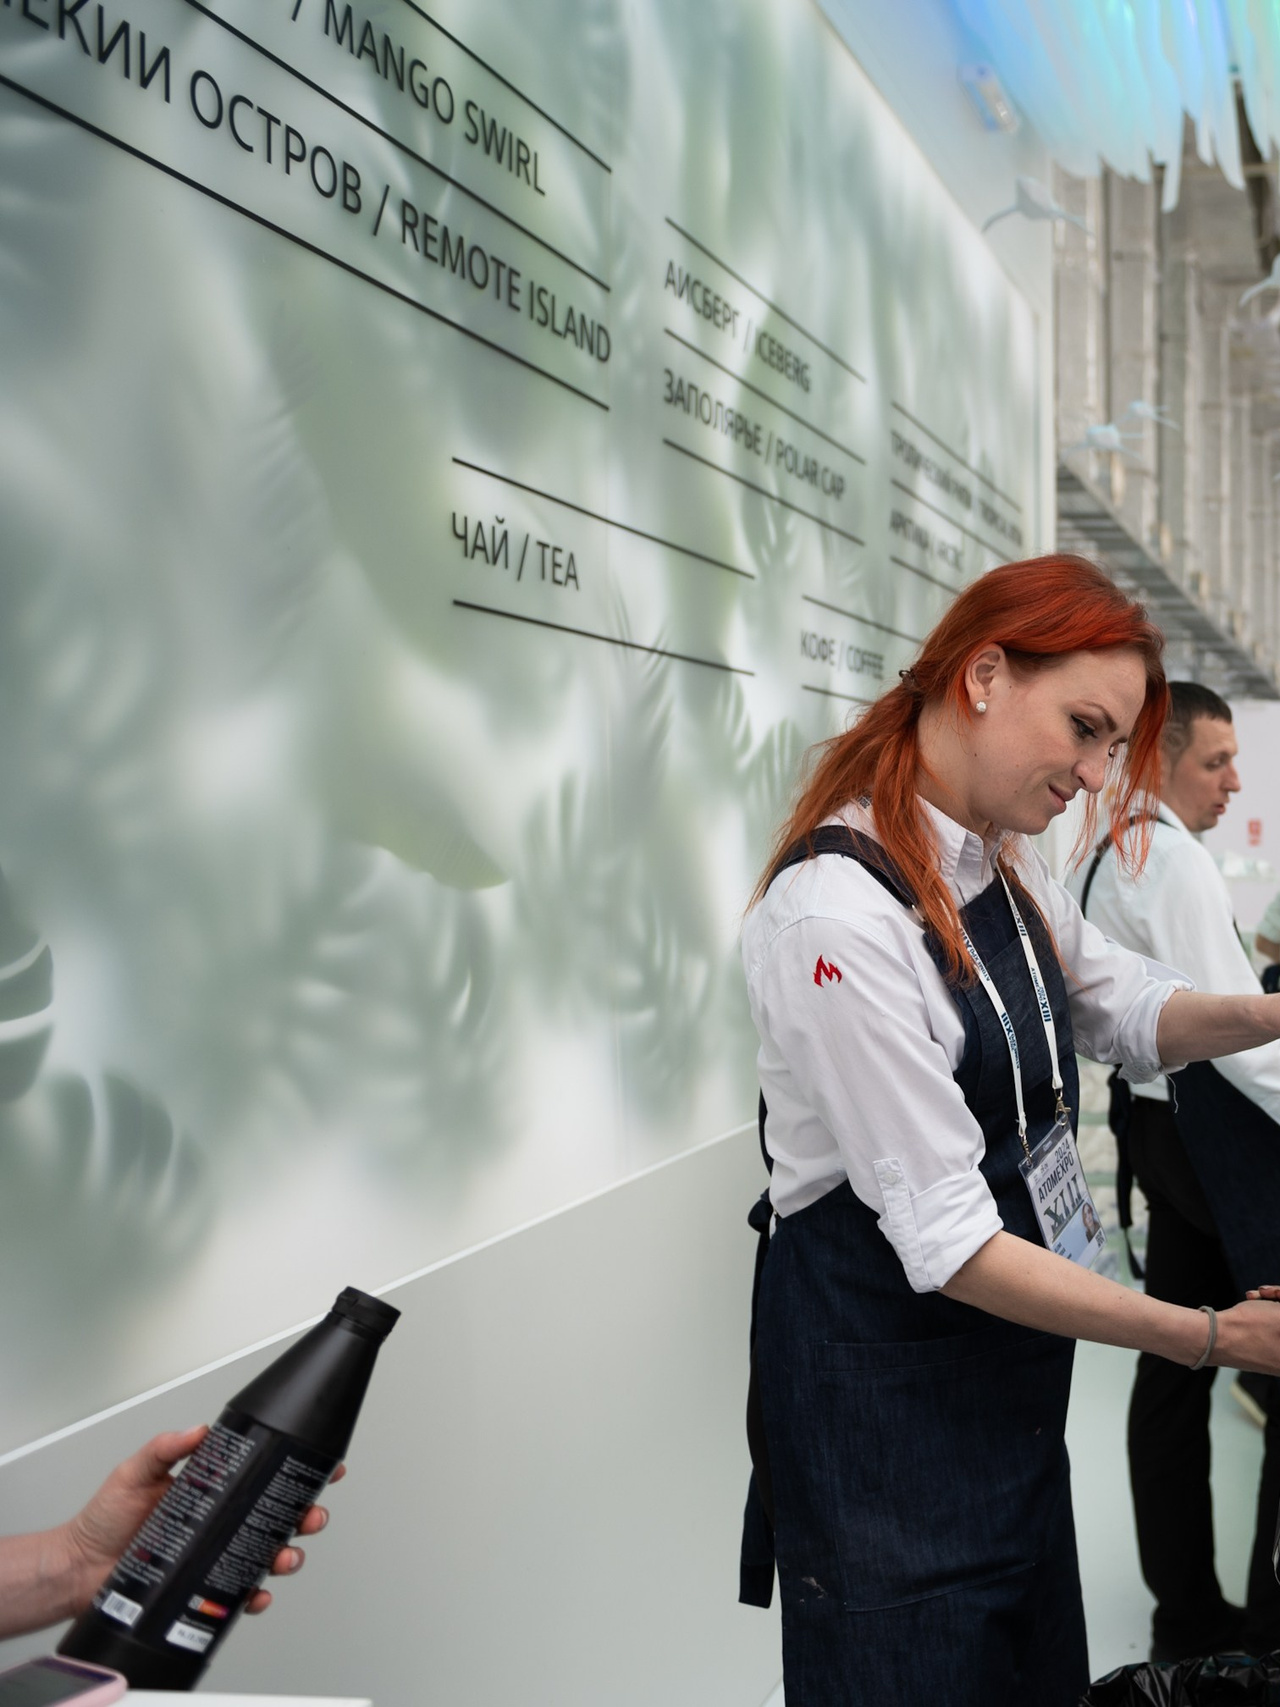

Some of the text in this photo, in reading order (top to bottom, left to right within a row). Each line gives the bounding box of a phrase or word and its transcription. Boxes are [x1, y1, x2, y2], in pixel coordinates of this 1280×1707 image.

[324, 0, 546, 196] MANGO SWIRL
[189, 69, 362, 214] ОСТРОВ
[401, 198, 521, 311] REMOTE
[528, 279, 611, 364] ISLAND
[754, 326, 811, 393] ICEBERG
[663, 368, 762, 457] ЗАПОЛЯРЬЕ
[775, 437, 819, 488] POLAR
[821, 465, 846, 502] CAP
[451, 512, 509, 570] ЧАЙ
[536, 540, 580, 590] TEA
[800, 629, 836, 667] КОФЕ
[1001, 1012, 1013, 1036] XIII
[1040, 1001, 1052, 1023] XIII
[1038, 1151, 1075, 1204] ATOMEXPO
[1054, 1138, 1070, 1163] 2024
